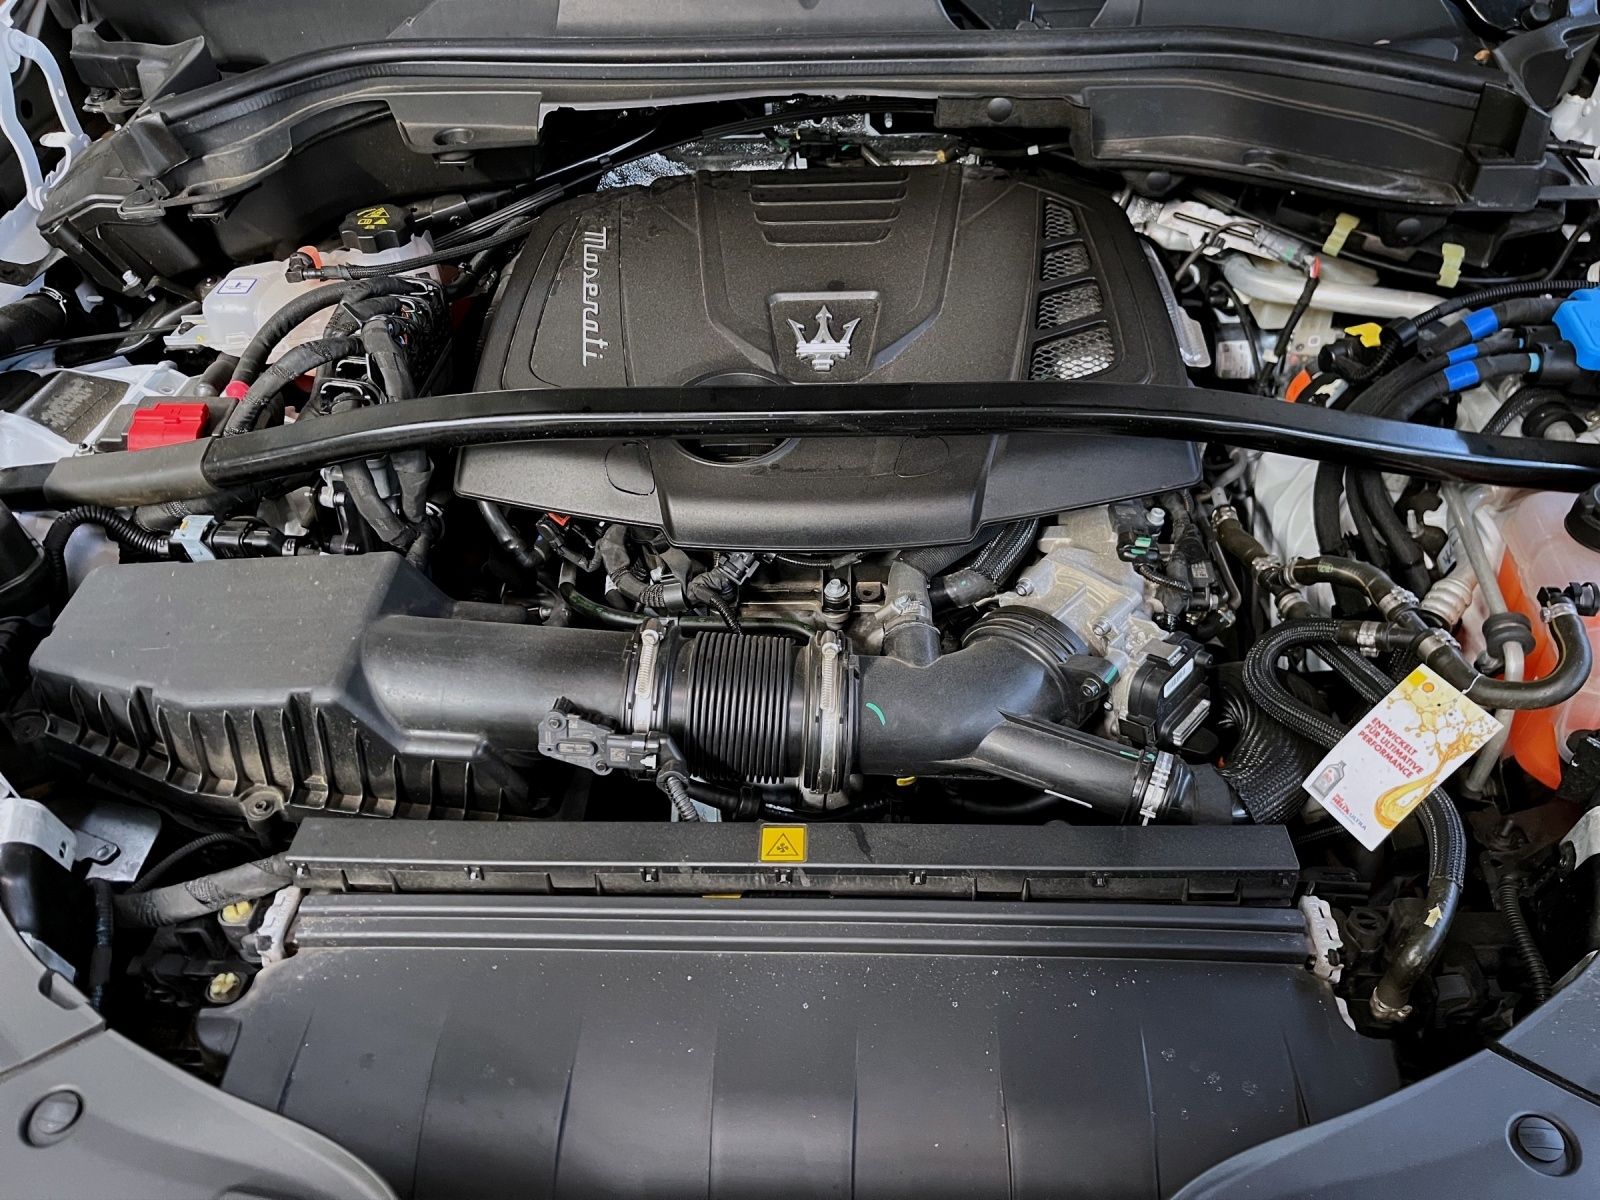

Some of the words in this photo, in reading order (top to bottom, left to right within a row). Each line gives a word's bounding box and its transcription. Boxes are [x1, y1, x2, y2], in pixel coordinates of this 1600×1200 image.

[582, 226, 609, 367] Maserati
[1358, 730, 1414, 778] PERFORMANCE
[1364, 724, 1380, 738] FÜR
[1380, 736, 1424, 774] ULTIMATIVE
[1371, 717, 1418, 756] ENTWICKELT
[1332, 796, 1350, 815] HELIX
[1349, 812, 1367, 831] ULTRA
